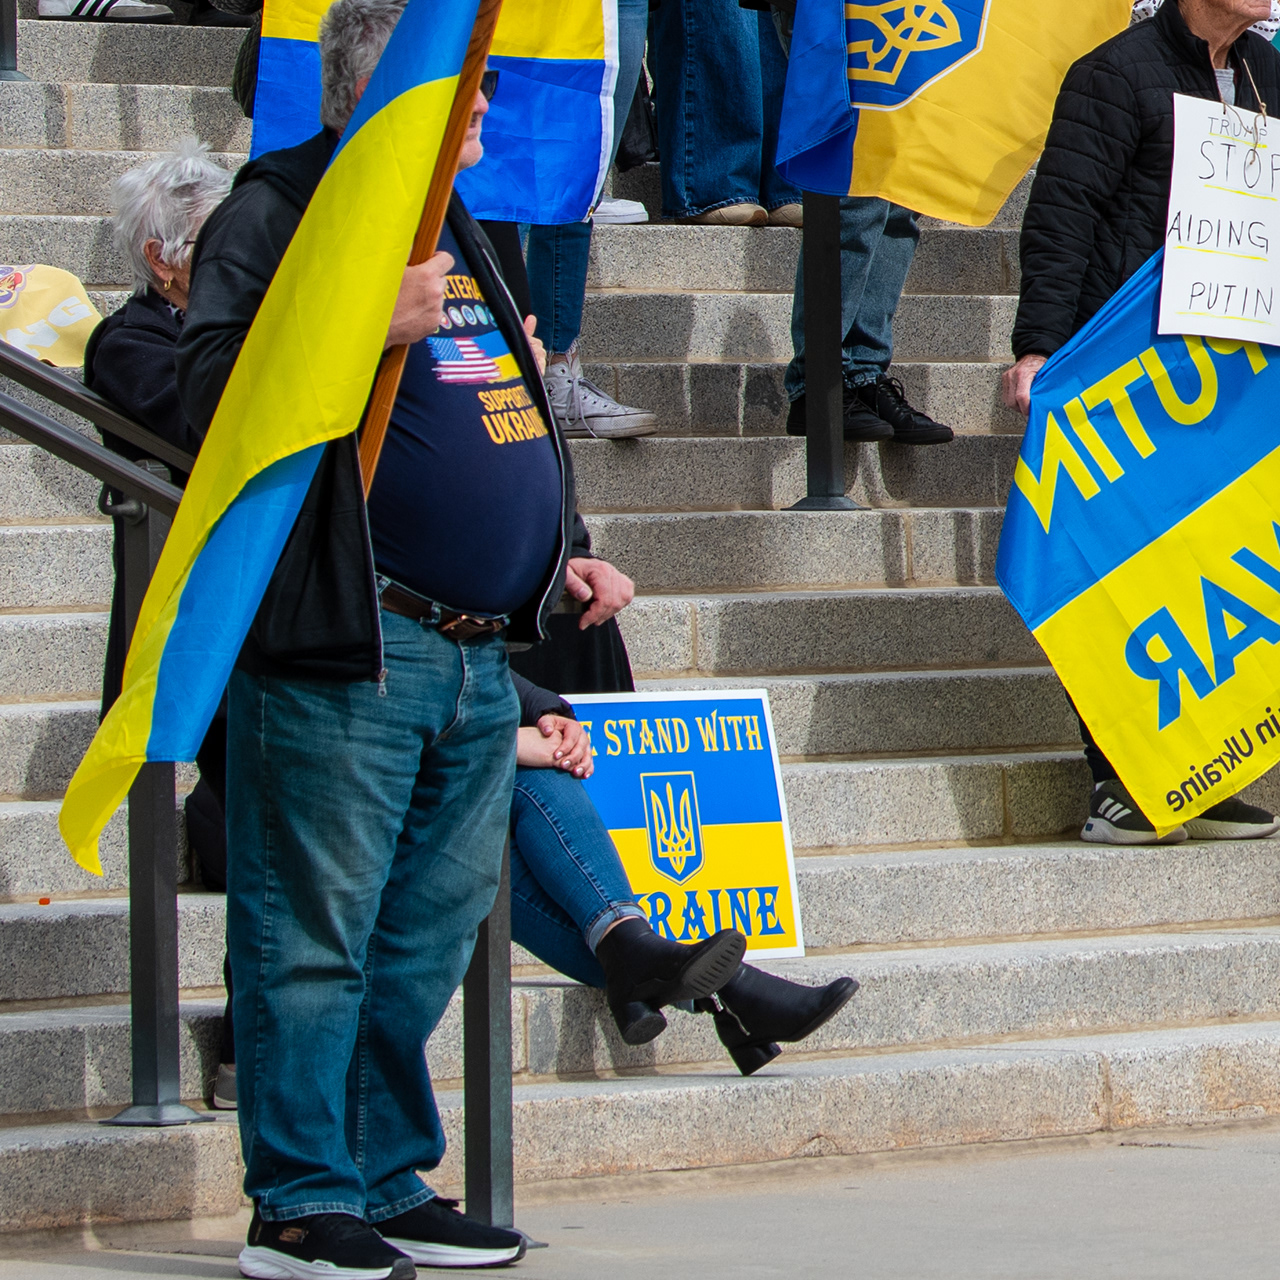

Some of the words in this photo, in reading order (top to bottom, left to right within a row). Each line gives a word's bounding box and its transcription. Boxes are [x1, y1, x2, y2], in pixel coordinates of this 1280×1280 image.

[1167, 210, 1269, 254] AIDING
[1189, 281, 1274, 318] PUTIN
[603, 717, 690, 756] STAND
[695, 708, 764, 752] WITH
